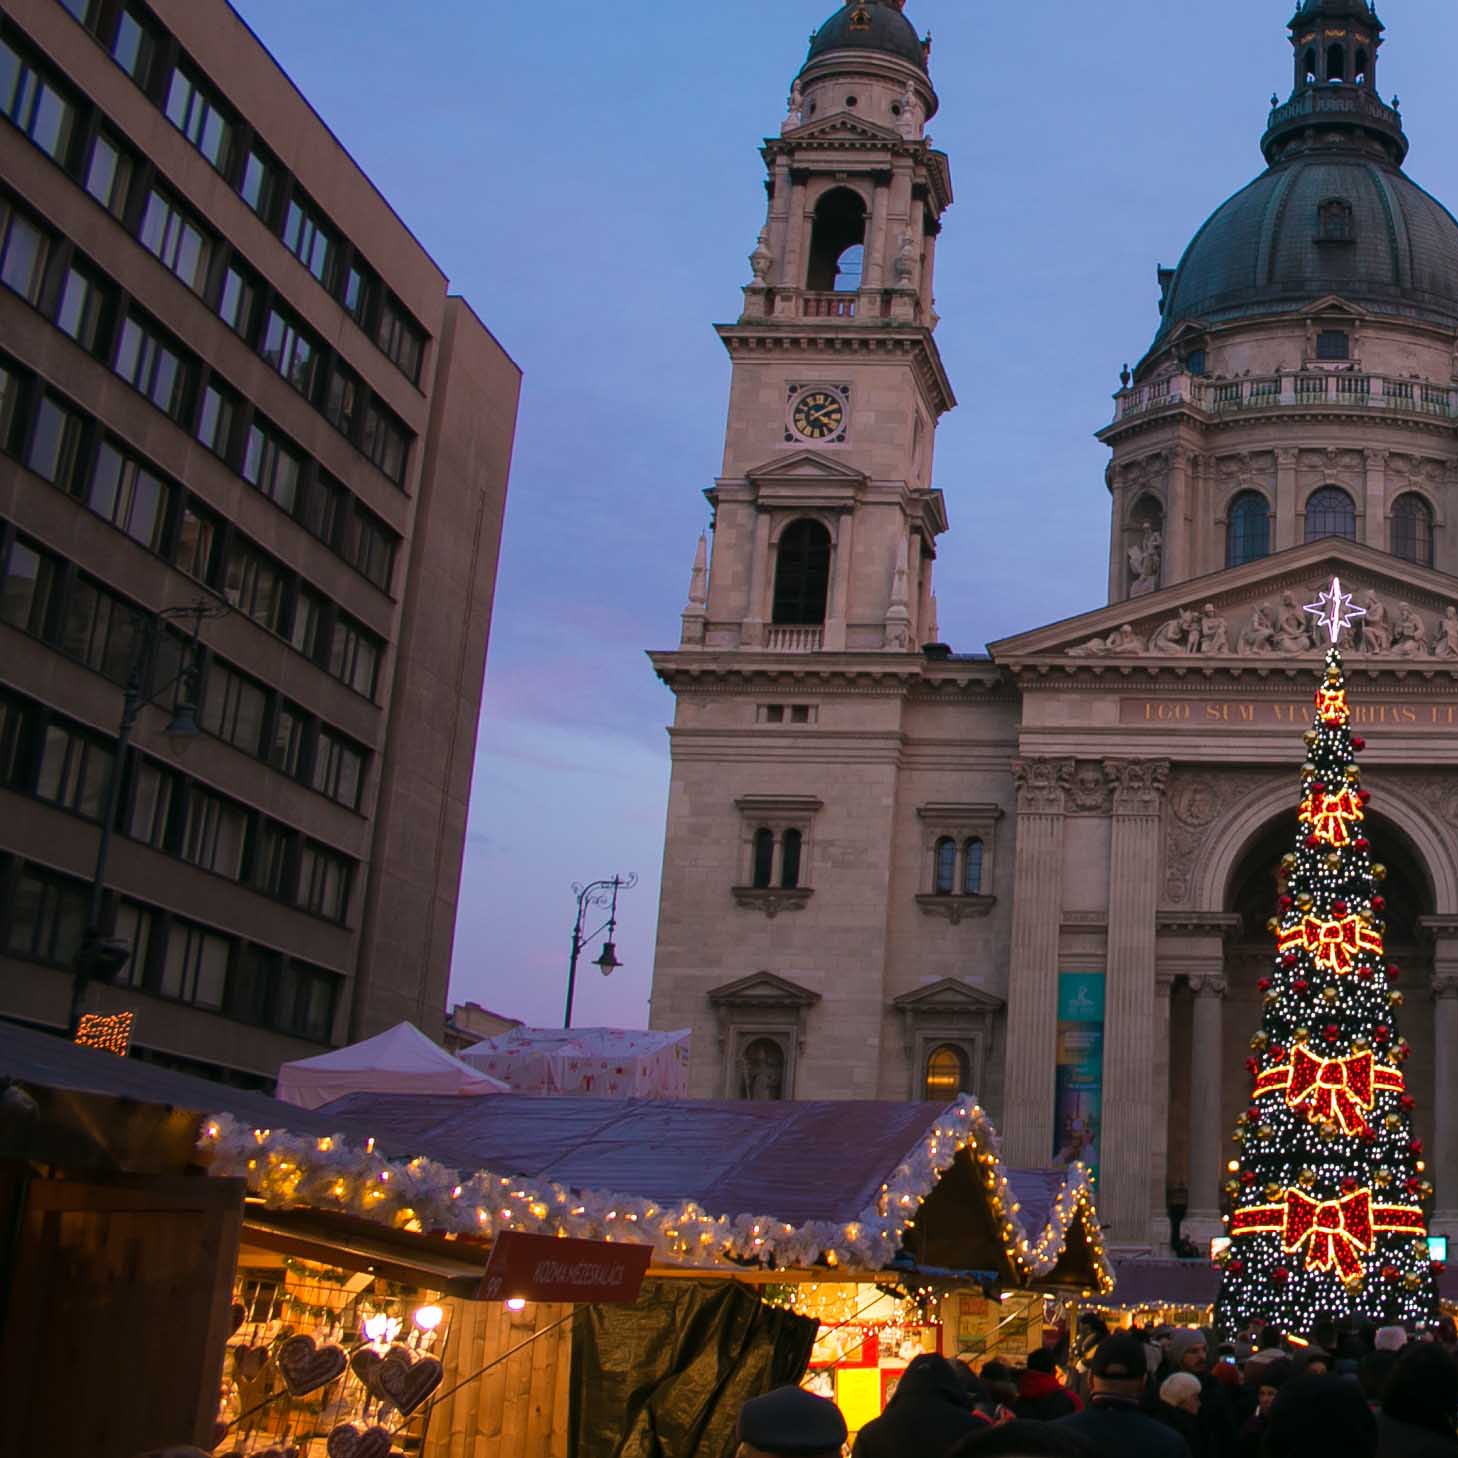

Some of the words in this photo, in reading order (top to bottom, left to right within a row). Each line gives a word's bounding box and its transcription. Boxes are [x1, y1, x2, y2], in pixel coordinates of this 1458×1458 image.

[1144, 703, 1190, 721] EGO
[1205, 703, 1254, 721] SUM
[1273, 704, 1312, 722] VIA
[1354, 704, 1416, 723] RITAS
[1431, 704, 1455, 723] ET
